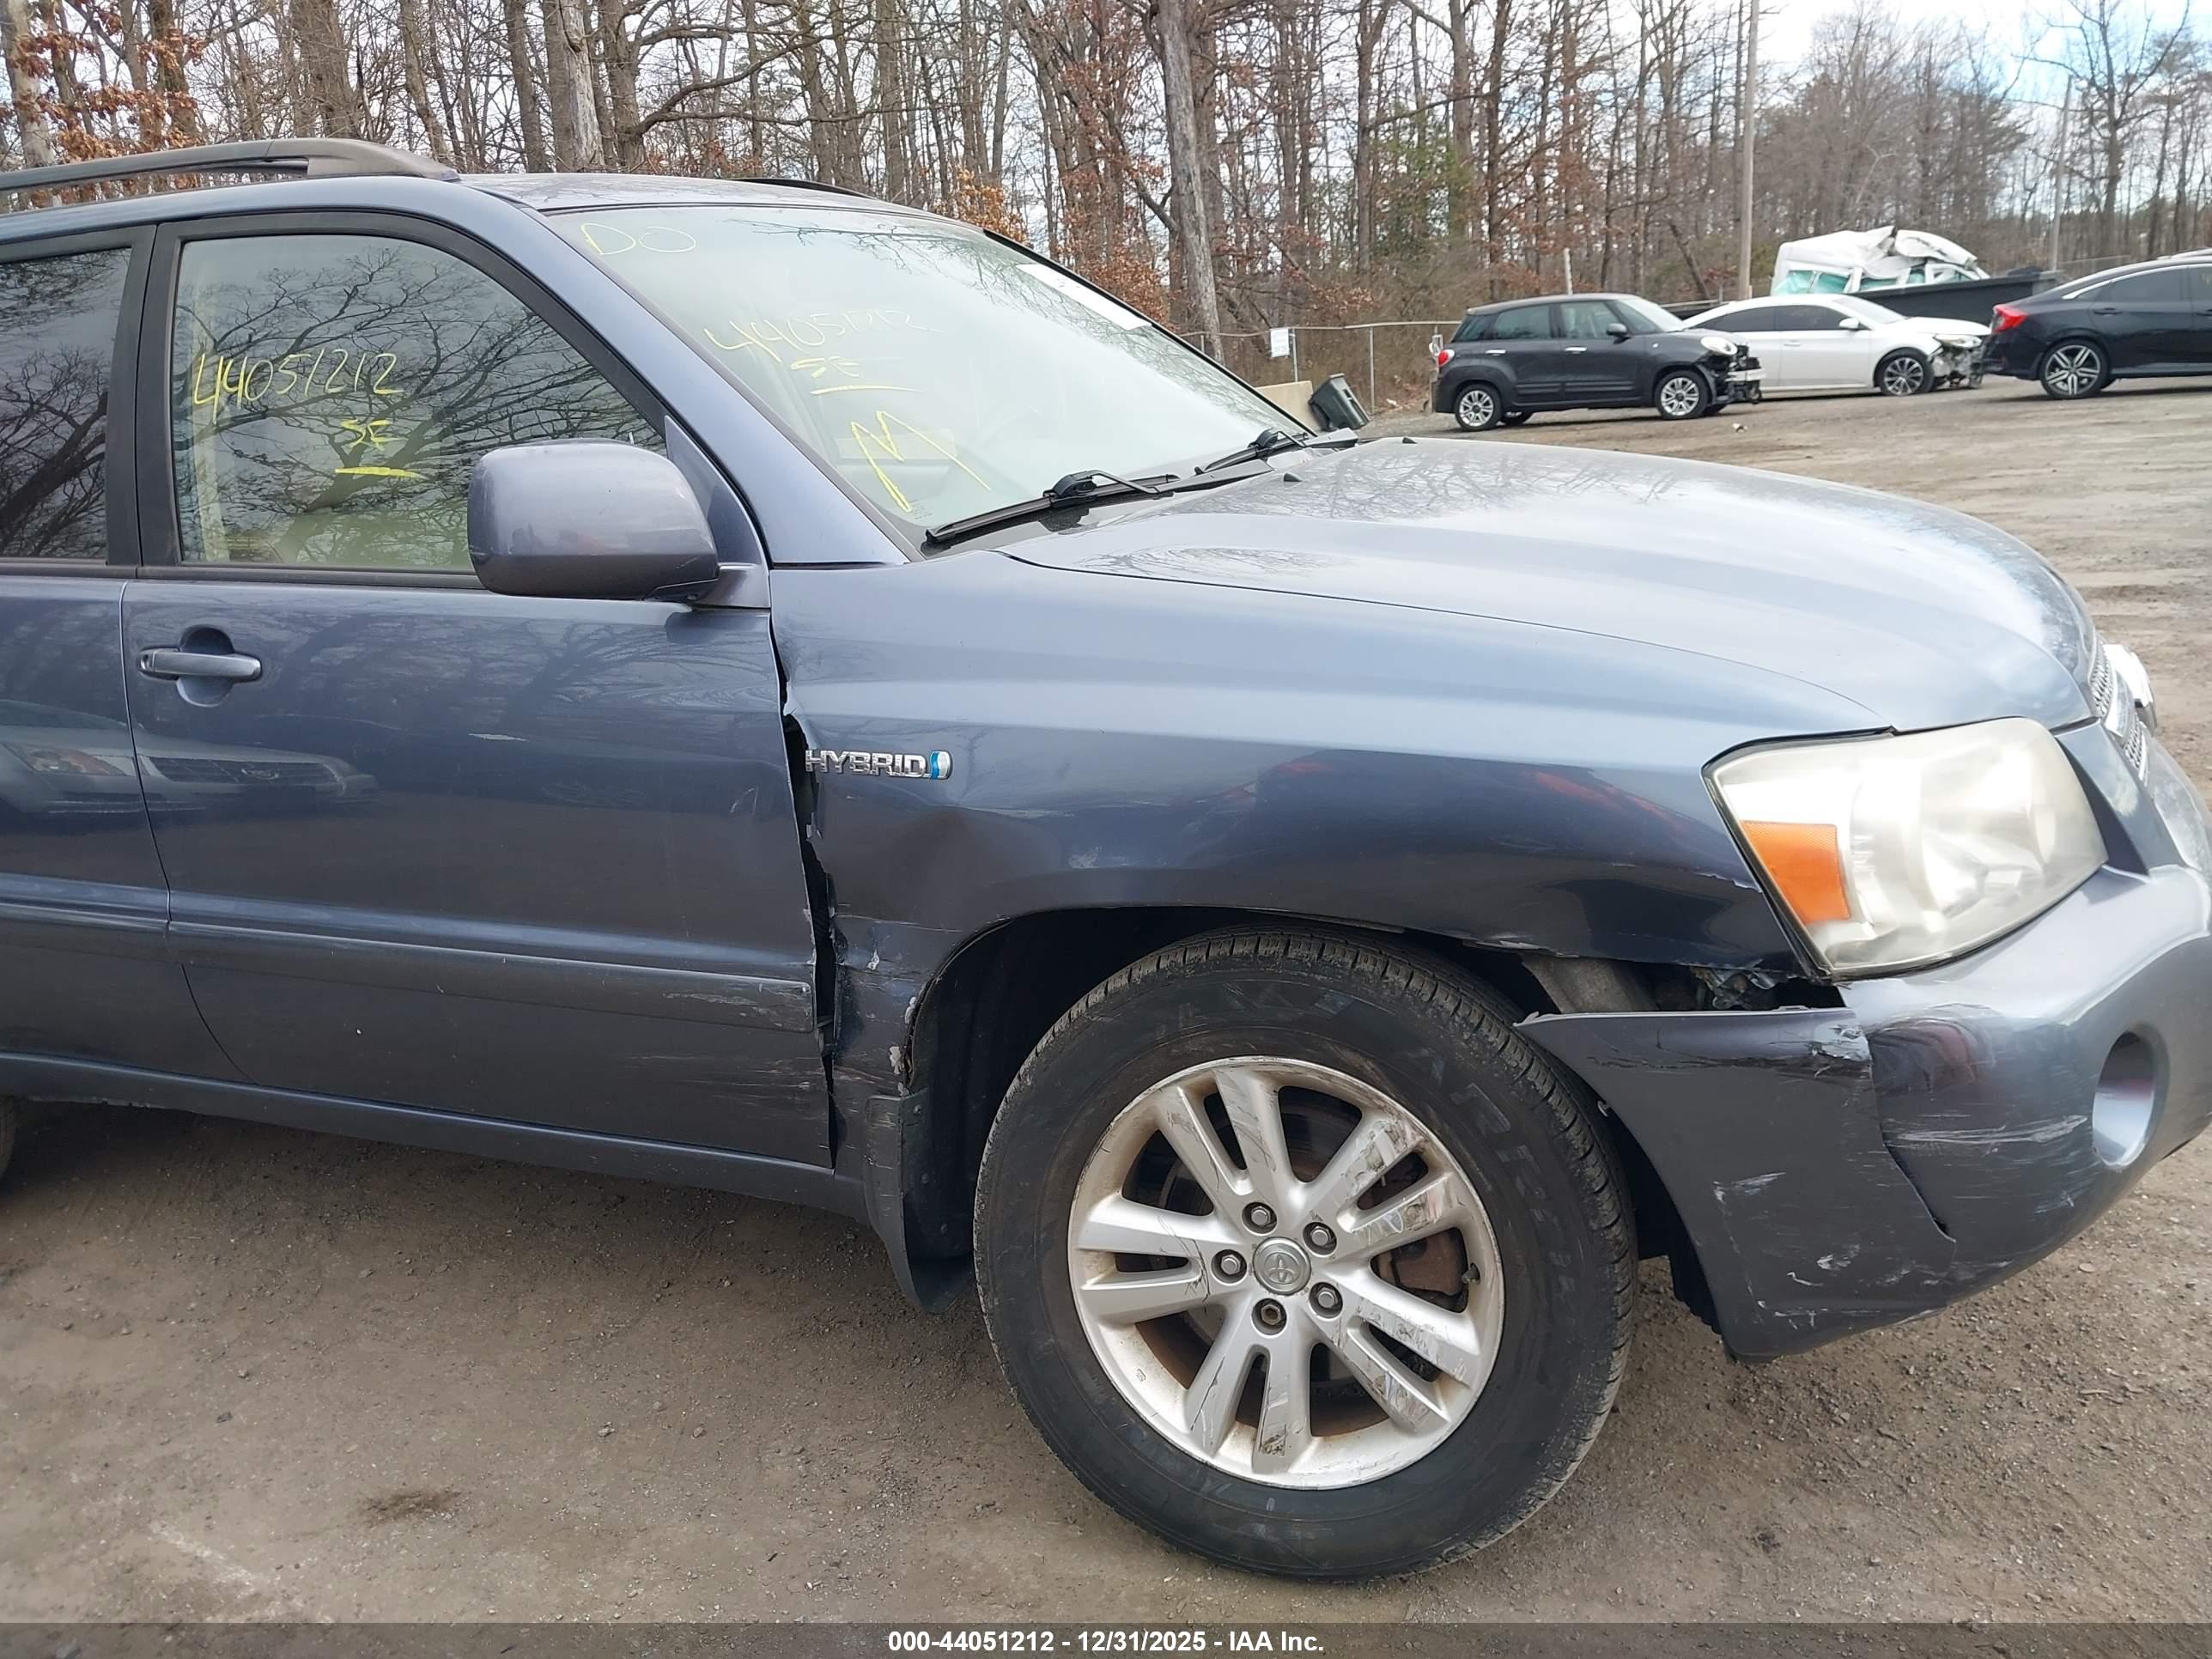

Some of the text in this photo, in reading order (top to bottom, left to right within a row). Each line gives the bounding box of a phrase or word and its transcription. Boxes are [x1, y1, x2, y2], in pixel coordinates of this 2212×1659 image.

[193, 348, 404, 425] 44051212
[851, 410, 992, 513] M
[805, 750, 928, 778] HYBRID
